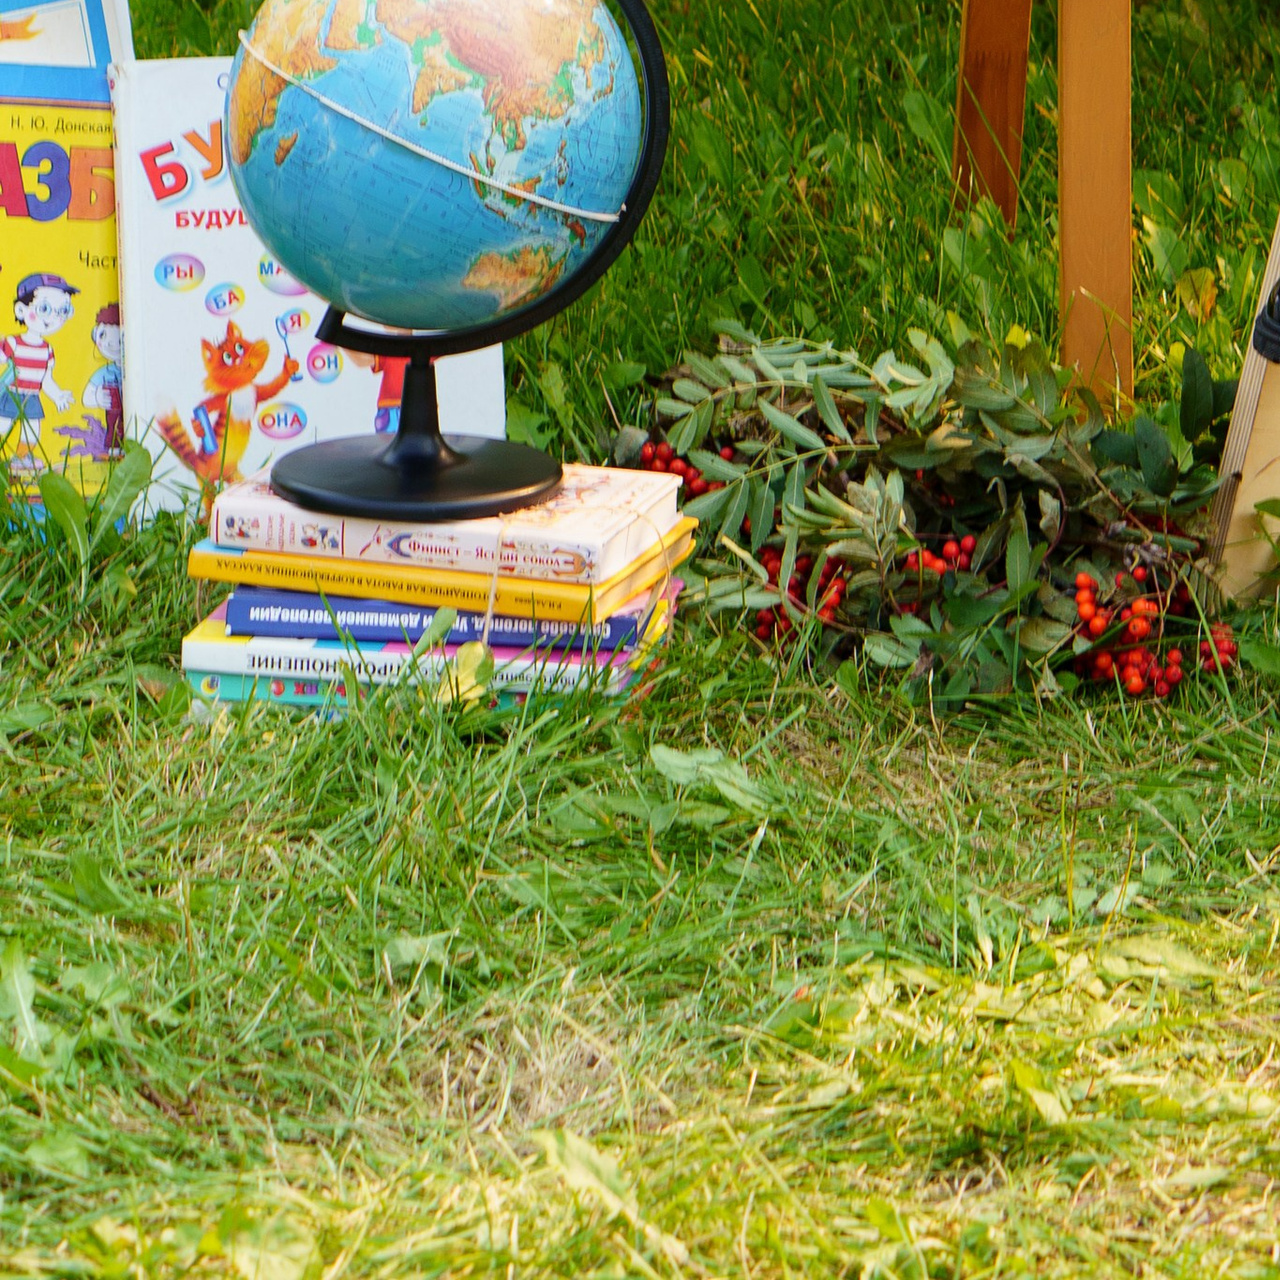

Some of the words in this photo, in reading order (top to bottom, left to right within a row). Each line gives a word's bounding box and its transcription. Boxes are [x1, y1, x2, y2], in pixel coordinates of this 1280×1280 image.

[10, 115, 25, 131] Н.
[30, 116, 49, 133] Ю.
[54, 117, 112, 135] Донская
[139, 117, 223, 202] БУ
[0, 139, 116, 222] АЗБ
[78, 250, 118, 271] Част
[163, 264, 194, 280] РЫ
[213, 289, 241, 310] БА
[290, 313, 302, 328] Я
[312, 355, 339, 371] ОН
[261, 412, 303, 429] ОНА
[408, 540, 460, 557] Финист
[423, 614, 467, 633] Ури
[247, 653, 402, 678] ПРОИНОШЕНИЕ
